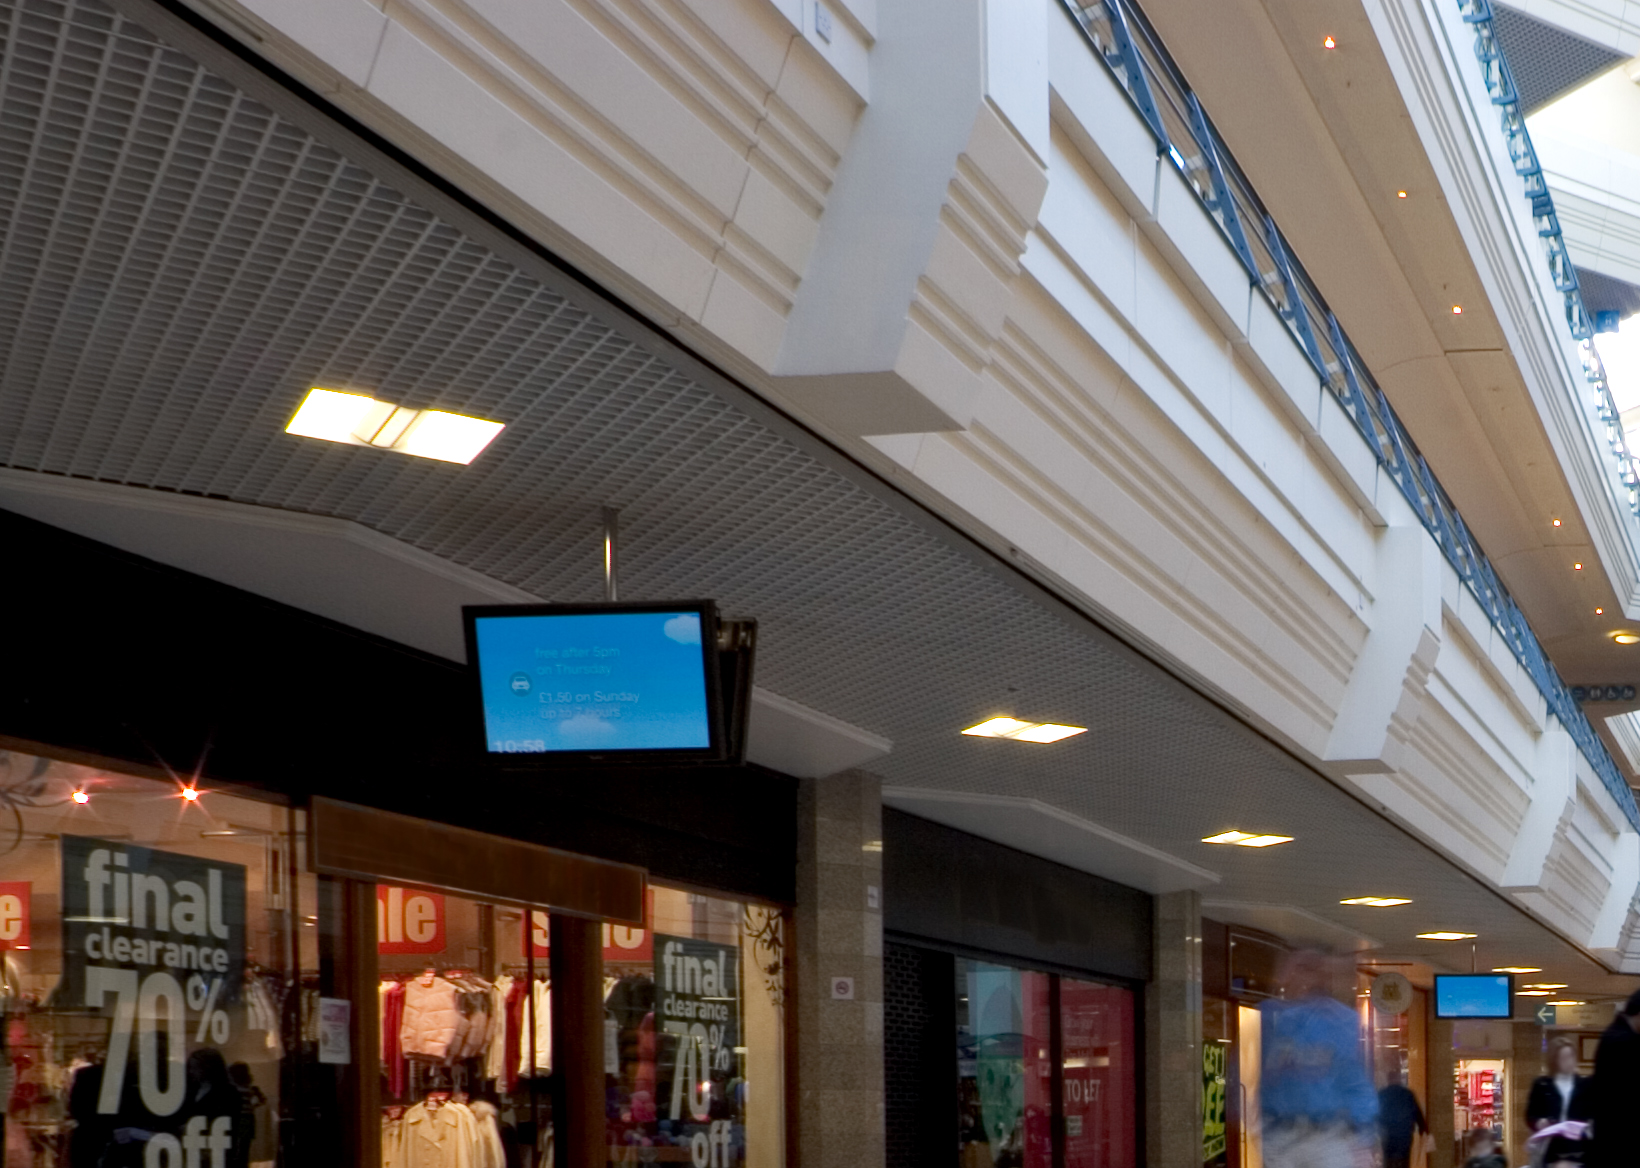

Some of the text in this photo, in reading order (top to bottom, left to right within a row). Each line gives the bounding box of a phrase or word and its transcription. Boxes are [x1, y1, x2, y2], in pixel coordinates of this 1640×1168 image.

[534, 645, 621, 660] free after 5pm
[537, 664, 612, 677] on Thursday
[539, 690, 640, 704] £1.50 on Sunday
[541, 710, 557, 720] up
[494, 740, 546, 753] 10:58
[84, 848, 230, 940] final
[85, 926, 230, 973] clearance
[663, 940, 728, 998] final
[663, 993, 729, 1022] clearance
[85, 965, 231, 1118] 70%
[663, 1020, 731, 1121] 70%
[1065, 1078, 1101, 1103] TO LET
